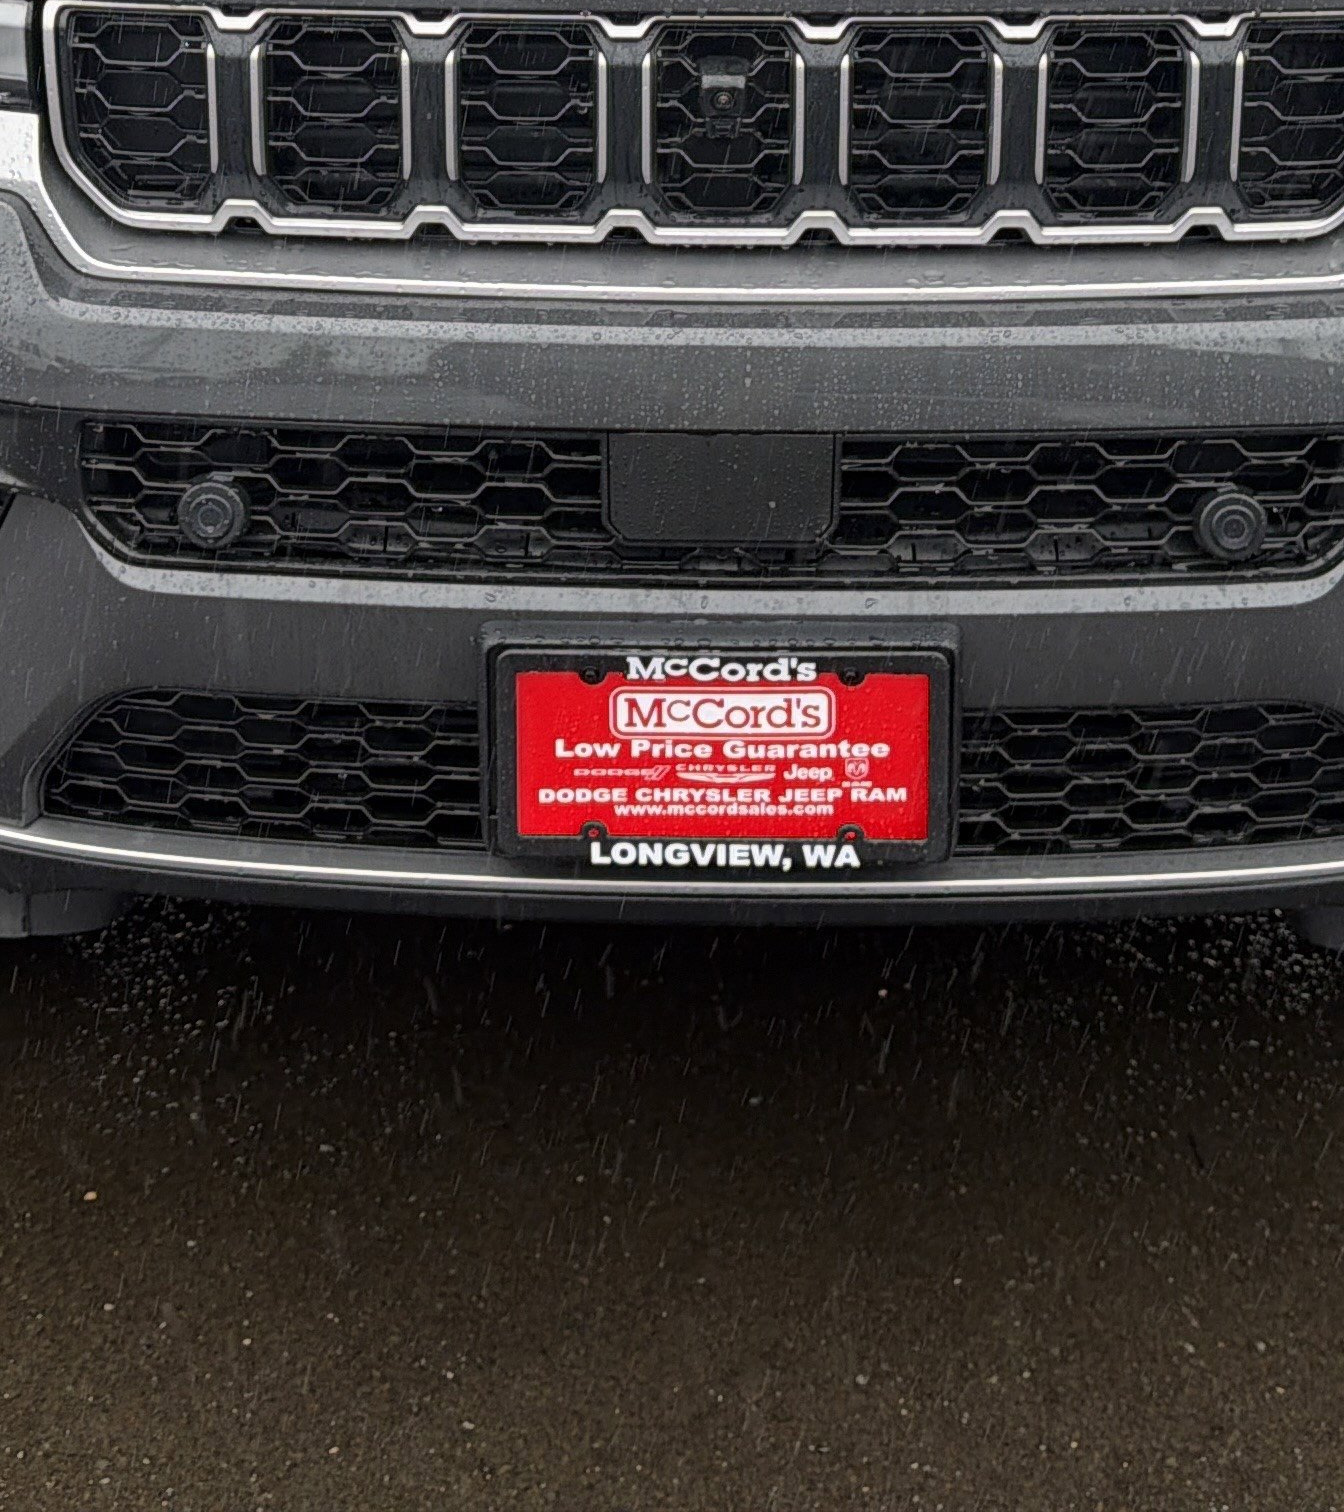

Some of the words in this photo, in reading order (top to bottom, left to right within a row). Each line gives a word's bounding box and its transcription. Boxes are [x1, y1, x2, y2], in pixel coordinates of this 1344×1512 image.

[626, 656, 817, 683] McCord's
[624, 696, 821, 729] McCord's
[555, 739, 620, 759] Low
[631, 739, 712, 759] Price
[722, 739, 890, 759] Guarantee
[783, 763, 833, 782] Jeep
[538, 788, 628, 803] DODGE
[635, 788, 771, 803] CHRYSLER
[778, 788, 843, 803] JEEP
[851, 788, 908, 802] RAM
[590, 843, 792, 871] LONGVIEW,
[802, 845, 861, 867] WA
